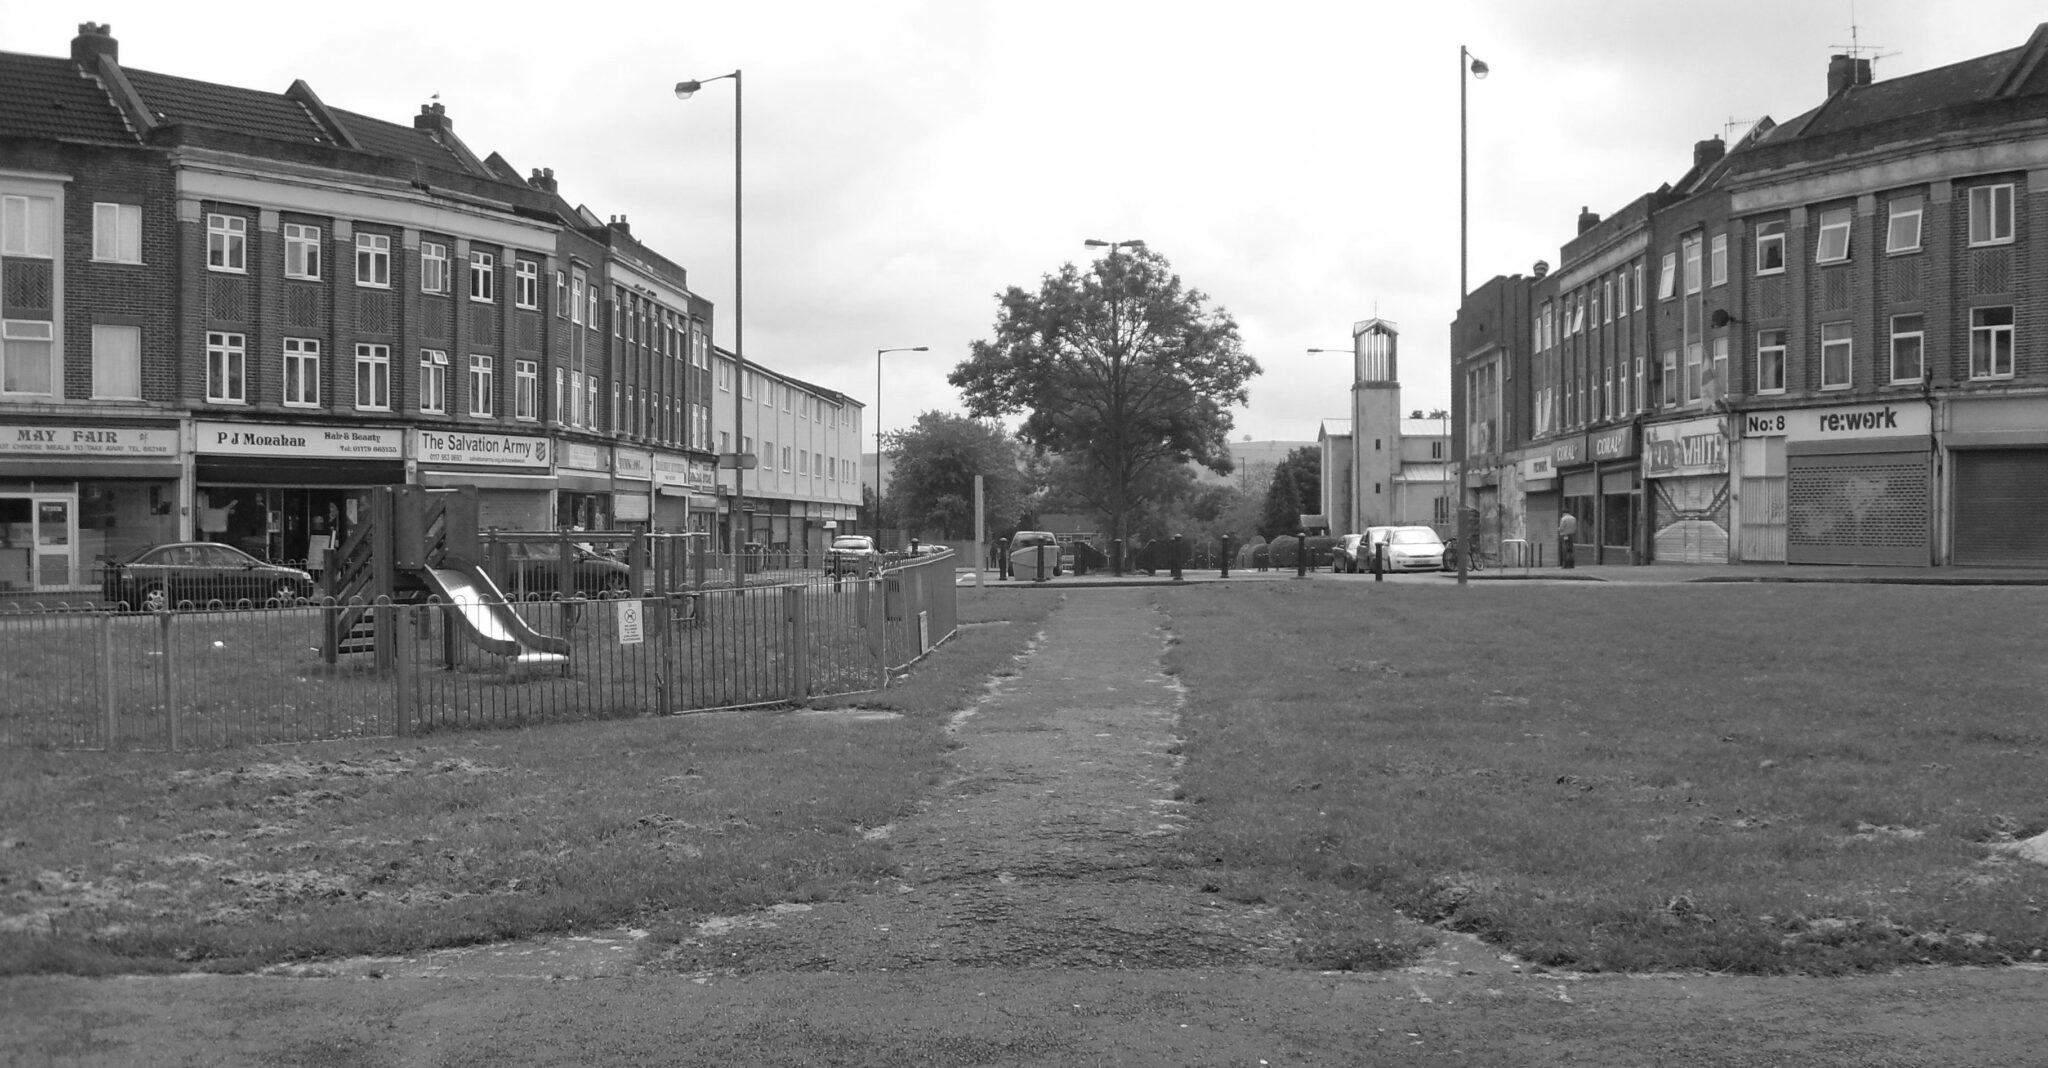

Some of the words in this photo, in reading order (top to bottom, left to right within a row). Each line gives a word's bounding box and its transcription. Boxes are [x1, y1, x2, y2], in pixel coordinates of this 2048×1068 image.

[1748, 416, 1773, 432] No:
[1776, 415, 1785, 431] 8
[1819, 406, 1898, 432] re:work
[18, 429, 56, 442] MAY
[73, 430, 117, 443] FAIR
[217, 431, 228, 445] P
[231, 432, 239, 445] J
[243, 432, 306, 447] Monahan
[324, 431, 343, 441] Hair
[86, 444, 104, 452] TAKE
[422, 433, 444, 450] The
[447, 434, 499, 453] Salvation
[502, 437, 532, 458] Army
[1557, 444, 1575, 462] CORAL
[1597, 436, 1618, 456] CORAL
[1681, 434, 1723, 466] WHITE
